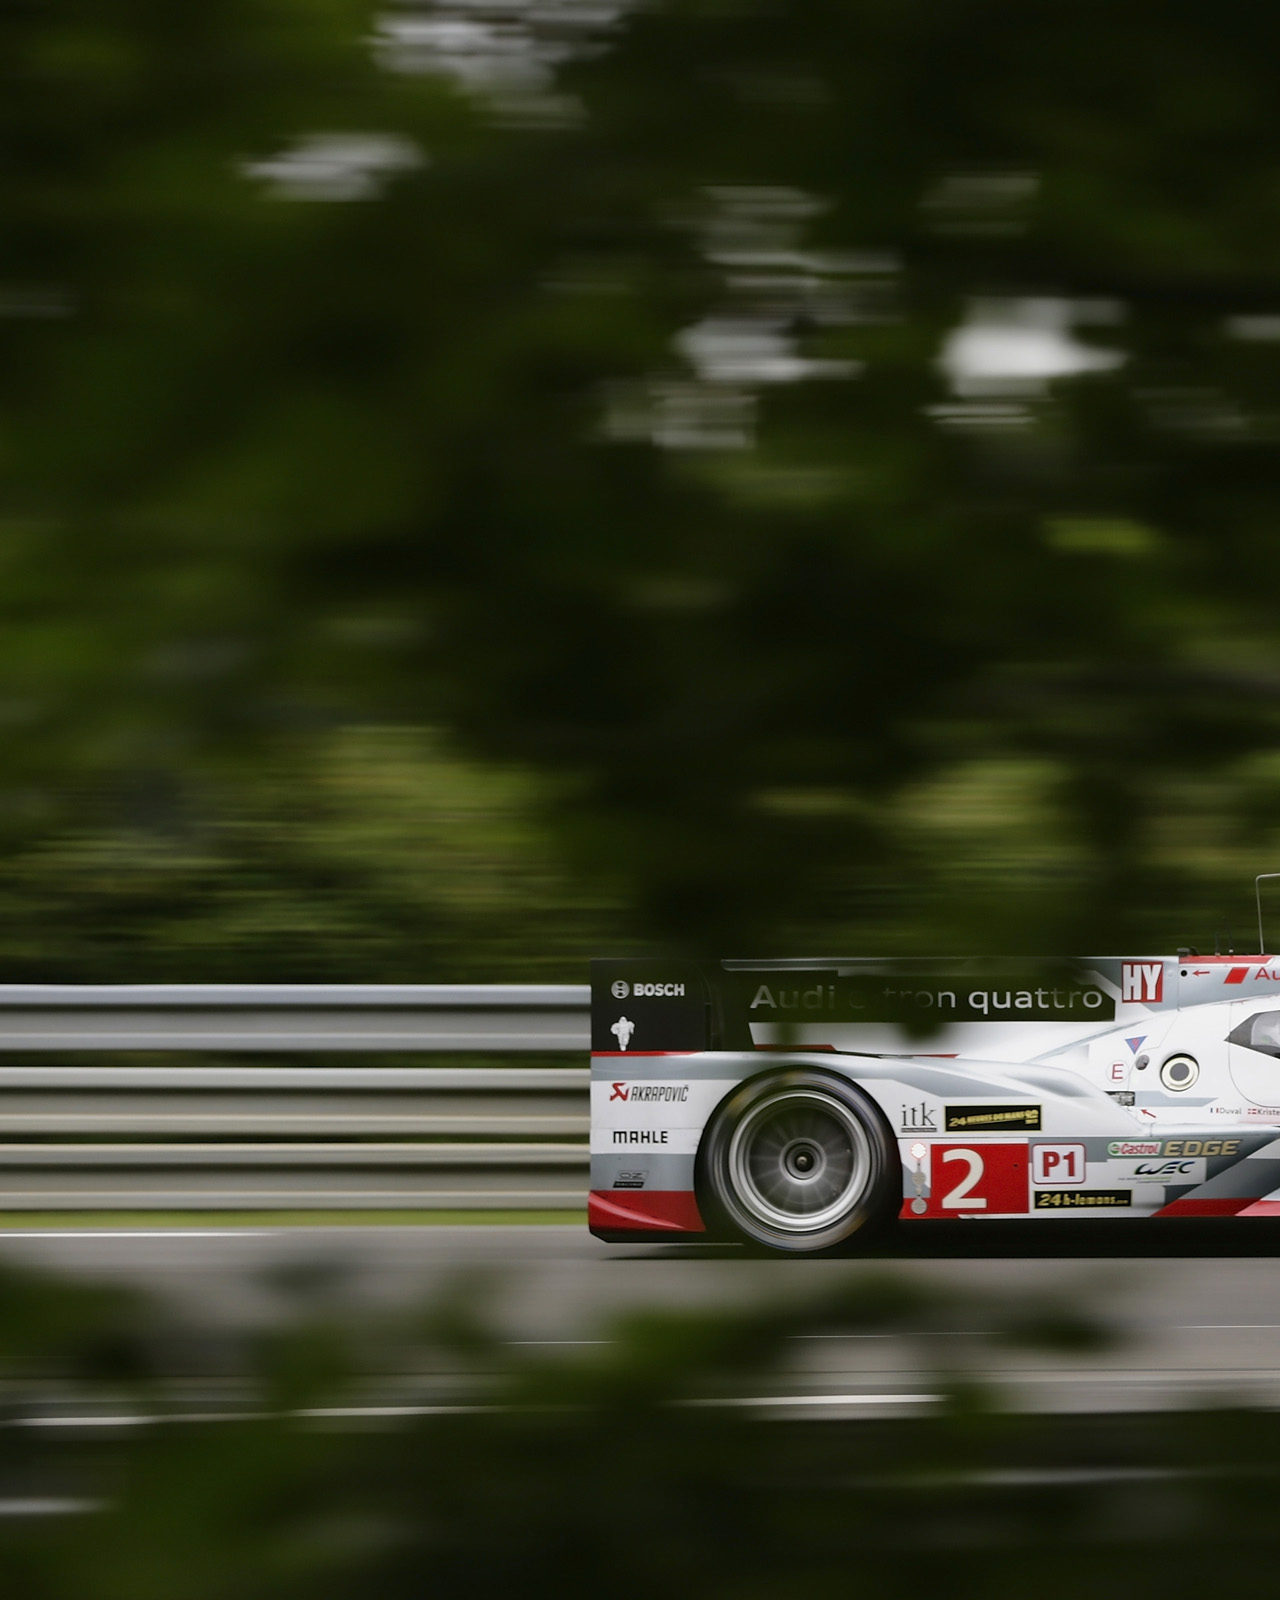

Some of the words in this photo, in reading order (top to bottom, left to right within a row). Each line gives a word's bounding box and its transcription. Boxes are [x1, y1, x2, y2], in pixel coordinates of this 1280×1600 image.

[633, 983, 685, 997] BOSCH
[1122, 964, 1161, 1001] HY
[750, 985, 835, 1009] Audi
[968, 988, 1102, 1015] quattro
[1111, 1063, 1124, 1080] E
[630, 1085, 688, 1102] AKRAPOVIČ
[901, 1102, 936, 1127] itk
[1219, 1107, 1242, 1115] Duval
[613, 1131, 668, 1144] MAHLE
[1121, 1143, 1159, 1155] Castrol
[1163, 1140, 1241, 1156] EDGE
[1042, 1151, 1075, 1177] P1
[1134, 1161, 1195, 1175] WEC
[941, 1148, 987, 1209] 2
[1037, 1193, 1062, 1206] 24
